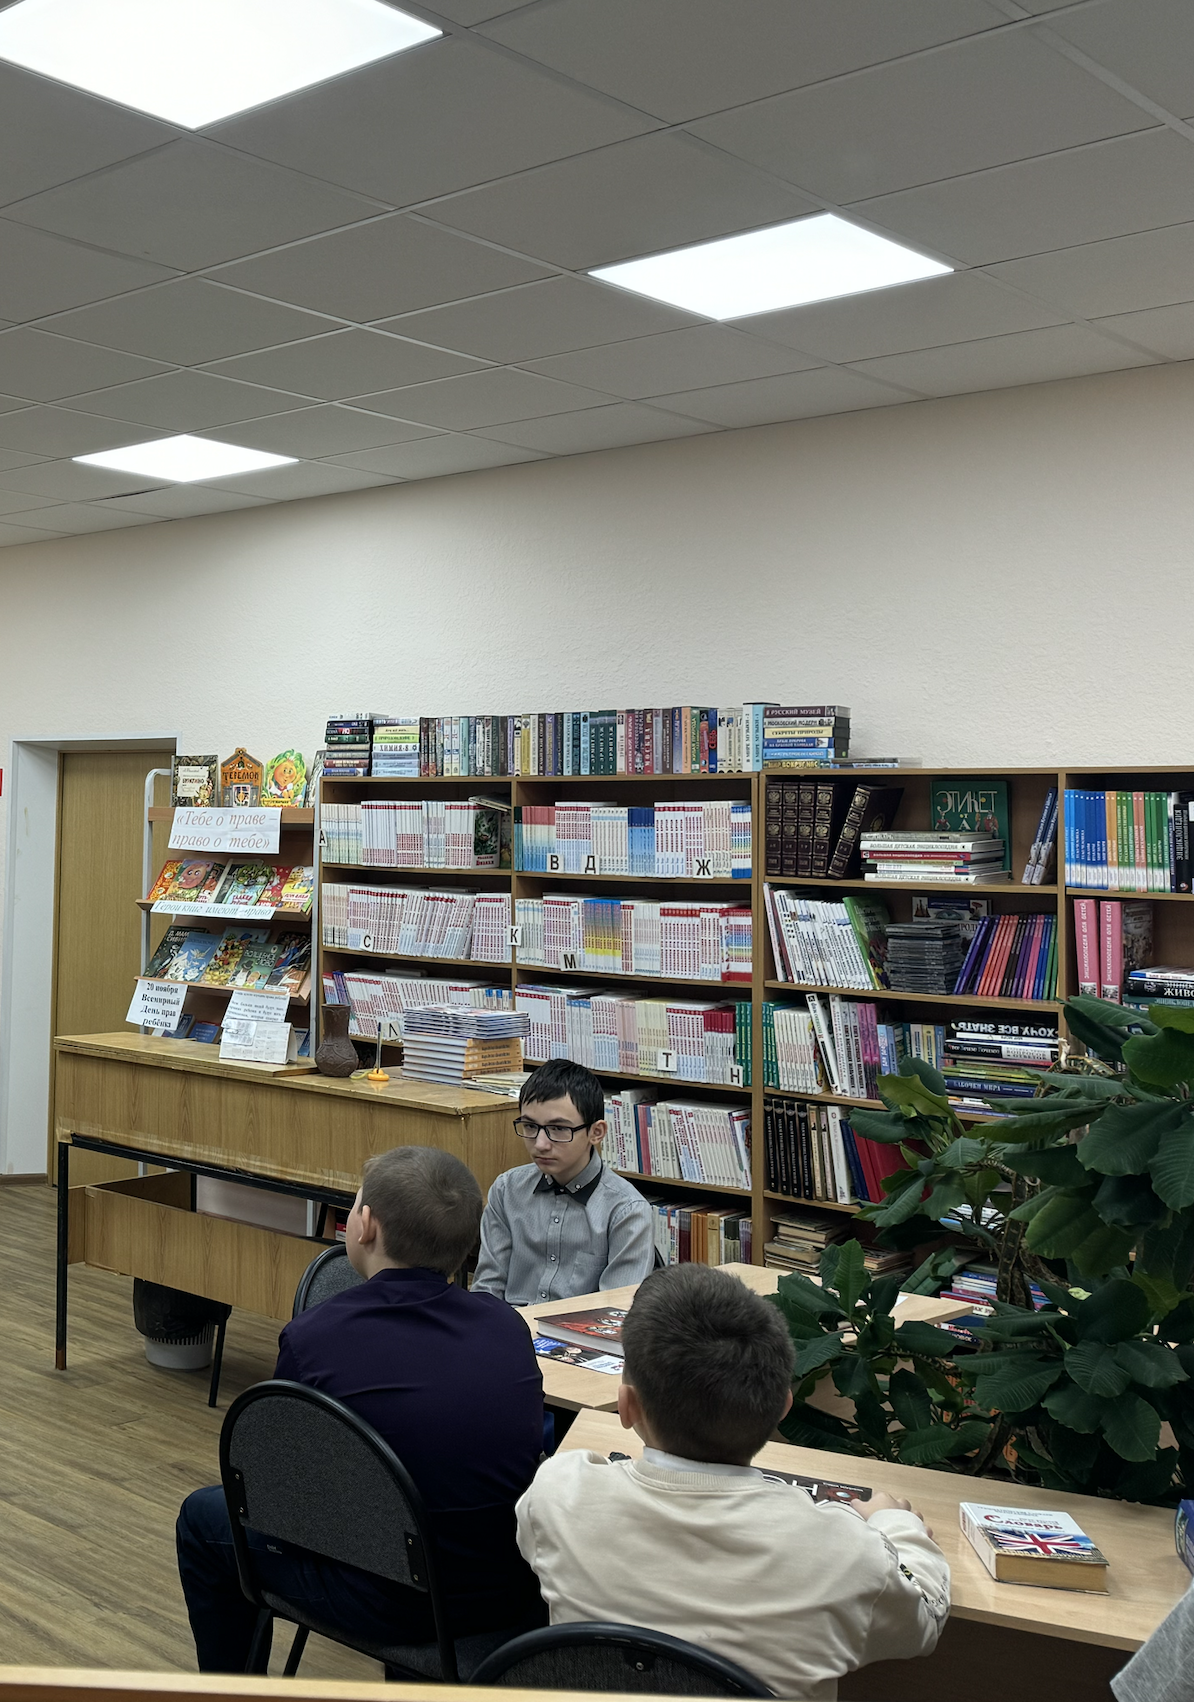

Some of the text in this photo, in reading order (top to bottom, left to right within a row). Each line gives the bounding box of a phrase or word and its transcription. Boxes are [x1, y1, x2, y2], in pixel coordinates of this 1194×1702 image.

[782, 760, 805, 769] ВОКРУГ
[806, 760, 818, 769] НАС
[222, 771, 259, 781] ТЕРЕМОК
[936, 791, 997, 813] ЭТИКЕТ
[177, 811, 266, 829] «Тебе о праве
[958, 819, 971, 831] А
[172, 833, 270, 849] право о тебе»
[319, 830, 326, 845] А
[1175, 810, 1183, 860] ЭНЦИКЛОПЕДИЯ
[550, 854, 560, 871] В
[584, 855, 597, 874] Д
[695, 859, 711, 876] Ж
[155, 901, 180, 912] Герои
[181, 904, 203, 913] книг
[362, 936, 371, 948] С
[510, 927, 519, 944] К
[563, 953, 577, 970] М
[147, 982, 179, 995] 20 ноября
[141, 993, 181, 1006] Всемирный
[140, 1004, 176, 1018] День прав
[142, 1018, 171, 1028] ребёнка
[957, 1021, 1055, 1038] ХОЧУ ВСЕ ЗНАТЬ
[662, 1052, 673, 1068] Т
[730, 1068, 740, 1084] Н
[983, 1084, 1001, 1092] МИРА
[984, 1514, 1063, 1530] Словарь
